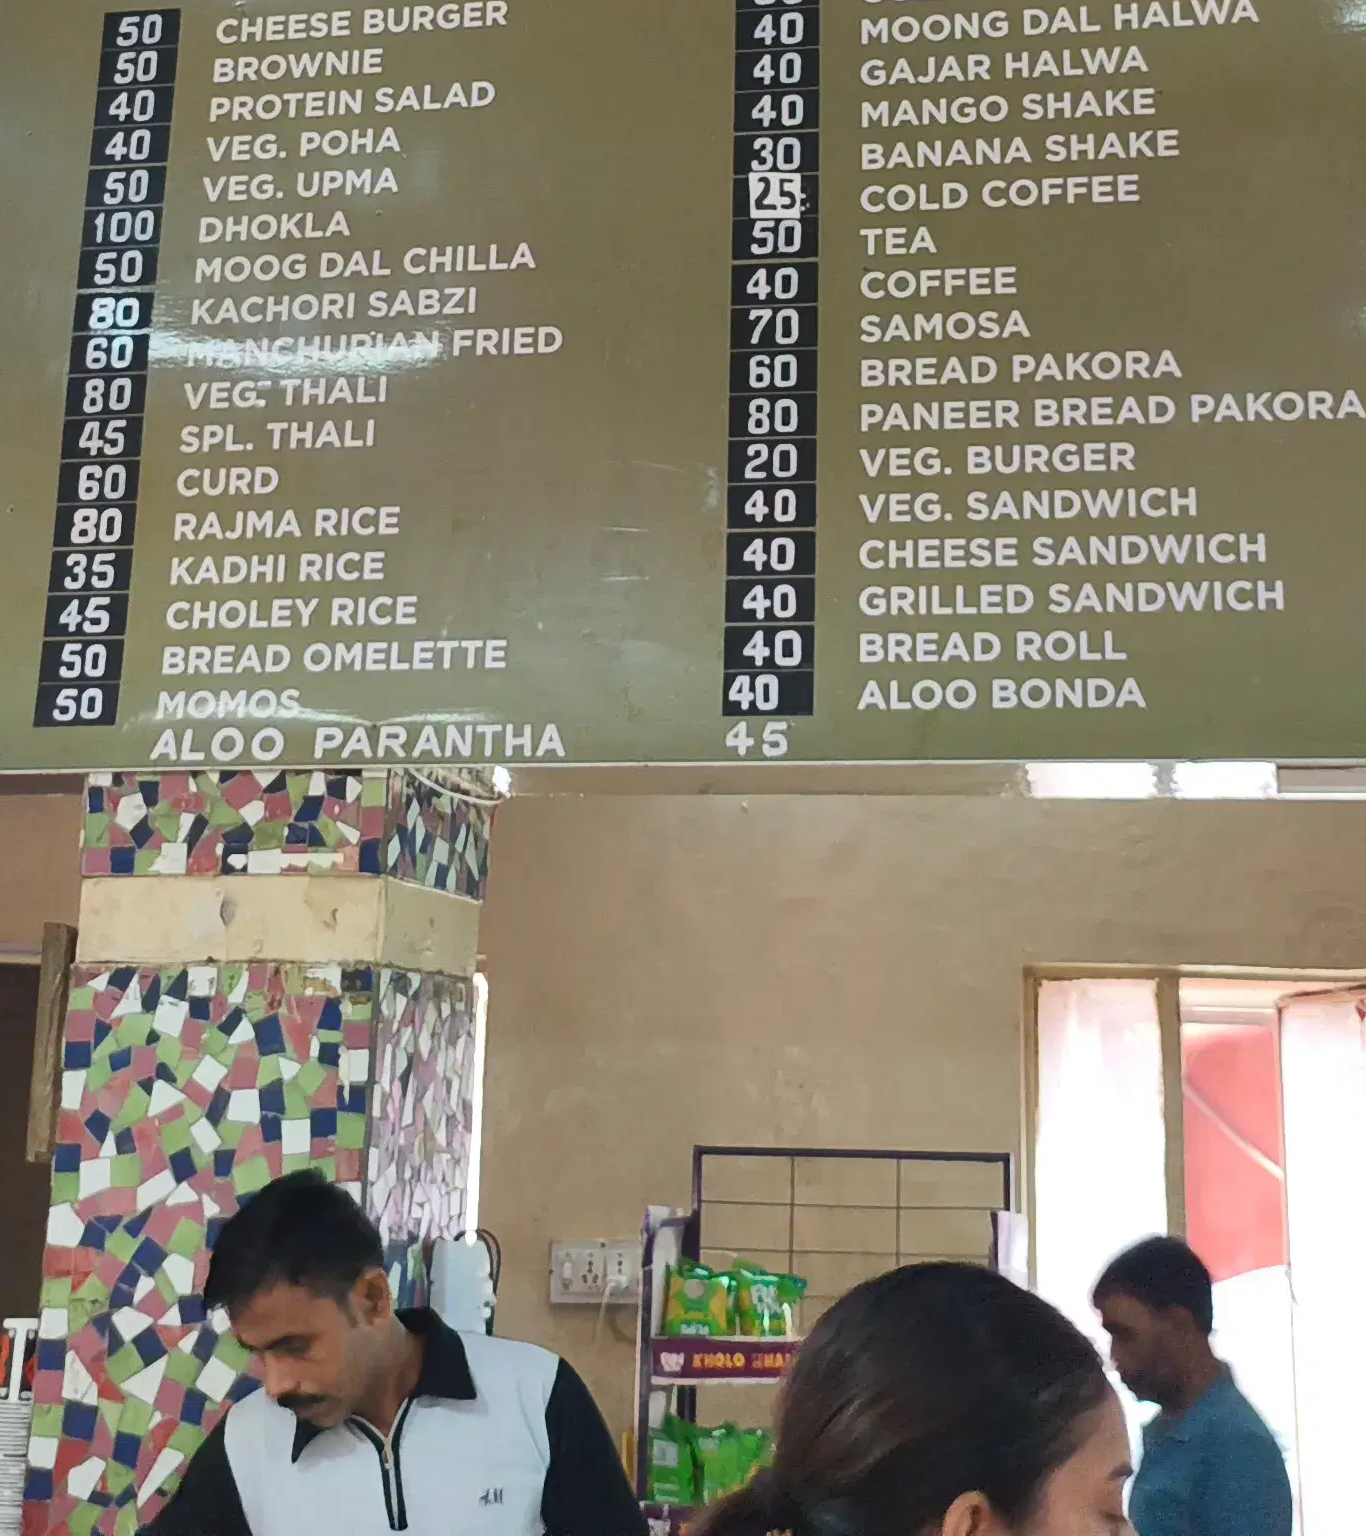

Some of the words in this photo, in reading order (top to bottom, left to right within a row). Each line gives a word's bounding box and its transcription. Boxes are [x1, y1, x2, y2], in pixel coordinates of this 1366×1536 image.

[754, 12, 803, 45] 40
[114, 51, 157, 83] 50
[211, 48, 384, 84] BROWNIE
[859, 52, 991, 86] GAJAR
[1003, 46, 1149, 79] HALWA
[752, 94, 803, 127] 40
[105, 129, 150, 161] 40
[205, 133, 287, 162] VEG.
[298, 127, 401, 156] POHA
[860, 136, 1033, 171] BANANA
[1044, 128, 1180, 162] SHAKE
[754, 175, 797, 212] 25
[95, 210, 154, 243] 100
[197, 210, 351, 243] DHOKLA
[858, 225, 938, 256] TEA
[89, 297, 139, 329] 80
[191, 292, 355, 325] KACHORI
[368, 287, 476, 317] SABZI
[749, 309, 798, 344] 70
[859, 309, 1031, 343] SAMOSA
[83, 378, 131, 411] 80
[184, 380, 267, 410] VEG.
[279, 375, 387, 405] THALI
[748, 398, 798, 434] 80
[859, 398, 1019, 433] PANEER
[1033, 394, 1176, 427] BREAD
[1189, 389, 1366, 423] PAKORA
[78, 465, 126, 498] 60
[175, 465, 279, 496] CURD
[745, 489, 796, 522] 40
[858, 492, 953, 523] VEG.
[965, 487, 1198, 521] SANDWICH
[64, 553, 115, 587] 35
[168, 553, 286, 584] KADHI
[297, 552, 386, 582] RICE
[743, 584, 796, 619] 40
[857, 583, 1035, 616] GRILLED
[1047, 579, 1285, 613] SANDWICH
[59, 644, 106, 677] 50
[160, 644, 291, 675] BREAD
[302, 640, 508, 672] OMELETTE
[729, 674, 778, 710] 40
[856, 678, 977, 709] ALOO
[991, 678, 1147, 708] BONDA
[148, 730, 285, 760] ALOO
[312, 726, 565, 758] PARANTHA
[725, 721, 788, 756] 45
